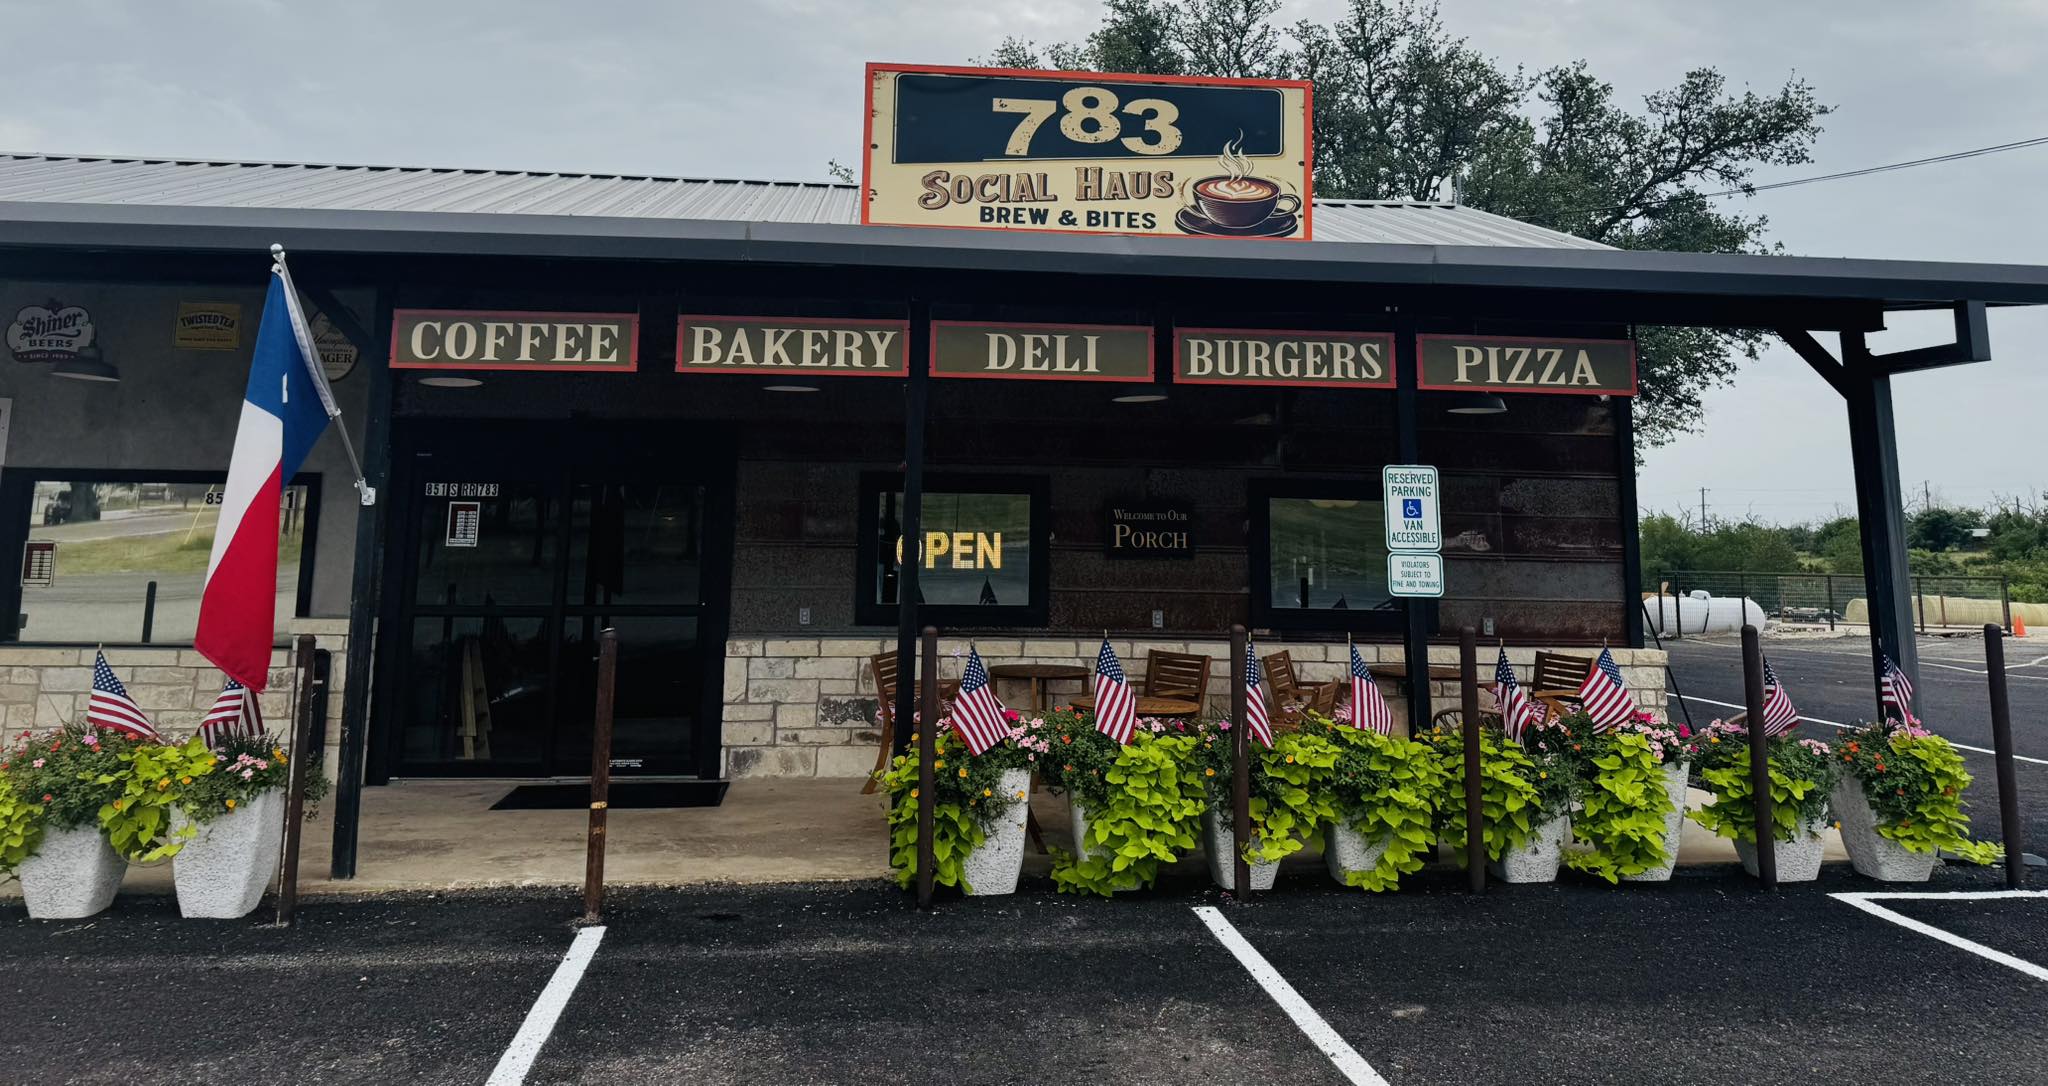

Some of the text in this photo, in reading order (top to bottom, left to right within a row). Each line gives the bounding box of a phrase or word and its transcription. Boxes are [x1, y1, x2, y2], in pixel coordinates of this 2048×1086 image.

[991, 86, 1183, 156] 783
[918, 166, 1176, 210] SOCIAL HAUS
[979, 205, 1157, 229] BREW & BITES
[20, 311, 83, 341] Shiner
[28, 338, 74, 348] BEERS
[410, 321, 619, 362] COFFEE
[688, 325, 899, 368] BAKERY
[983, 332, 1101, 372] DELI
[319, 352, 353, 364] AGER
[1185, 338, 1383, 380] BURGERS
[1451, 345, 1601, 386] PIZZA
[426, 483, 498, 496] 851 S RR 783
[1388, 473, 1433, 484] RESERVED
[1391, 486, 1431, 496] PARKING
[1112, 523, 1188, 549] PORCH
[1403, 520, 1423, 530] VAN
[1392, 532, 1436, 543] ACCESSIBLE
[1392, 580, 1439, 589] FINE AND TOWING
[1400, 570, 1422, 578] SUBJECT
